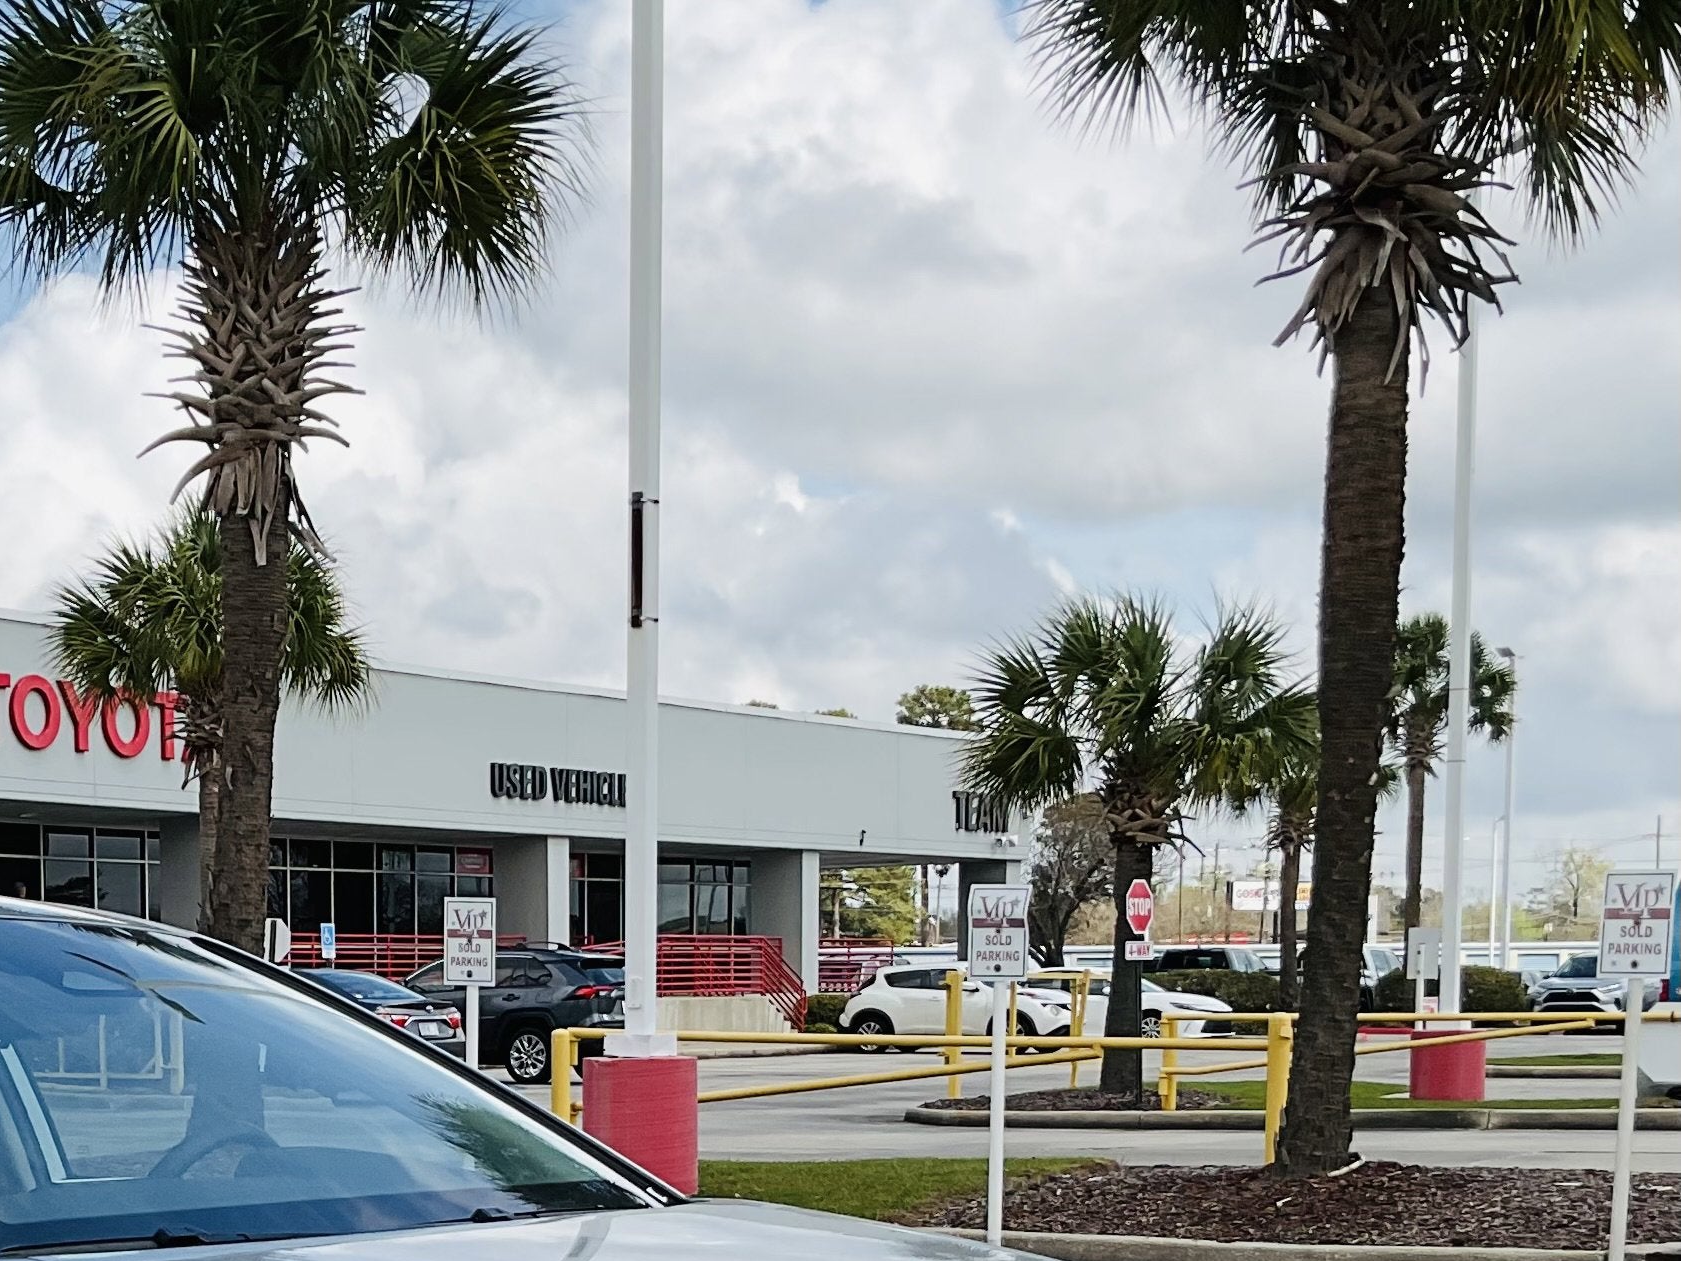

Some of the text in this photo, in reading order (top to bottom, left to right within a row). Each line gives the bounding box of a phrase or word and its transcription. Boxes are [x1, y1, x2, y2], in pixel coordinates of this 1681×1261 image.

[490, 763, 547, 800] USED
[1129, 897, 1151, 917] STOP
[1620, 926, 1653, 938] SOLD
[985, 935, 1012, 946] SOLD
[458, 943, 481, 953] SOLD
[1128, 945, 1151, 957] 4-WAY
[1607, 943, 1662, 955] PARKING
[450, 957, 488, 967] PARKING
[976, 951, 1020, 961] PARKING
